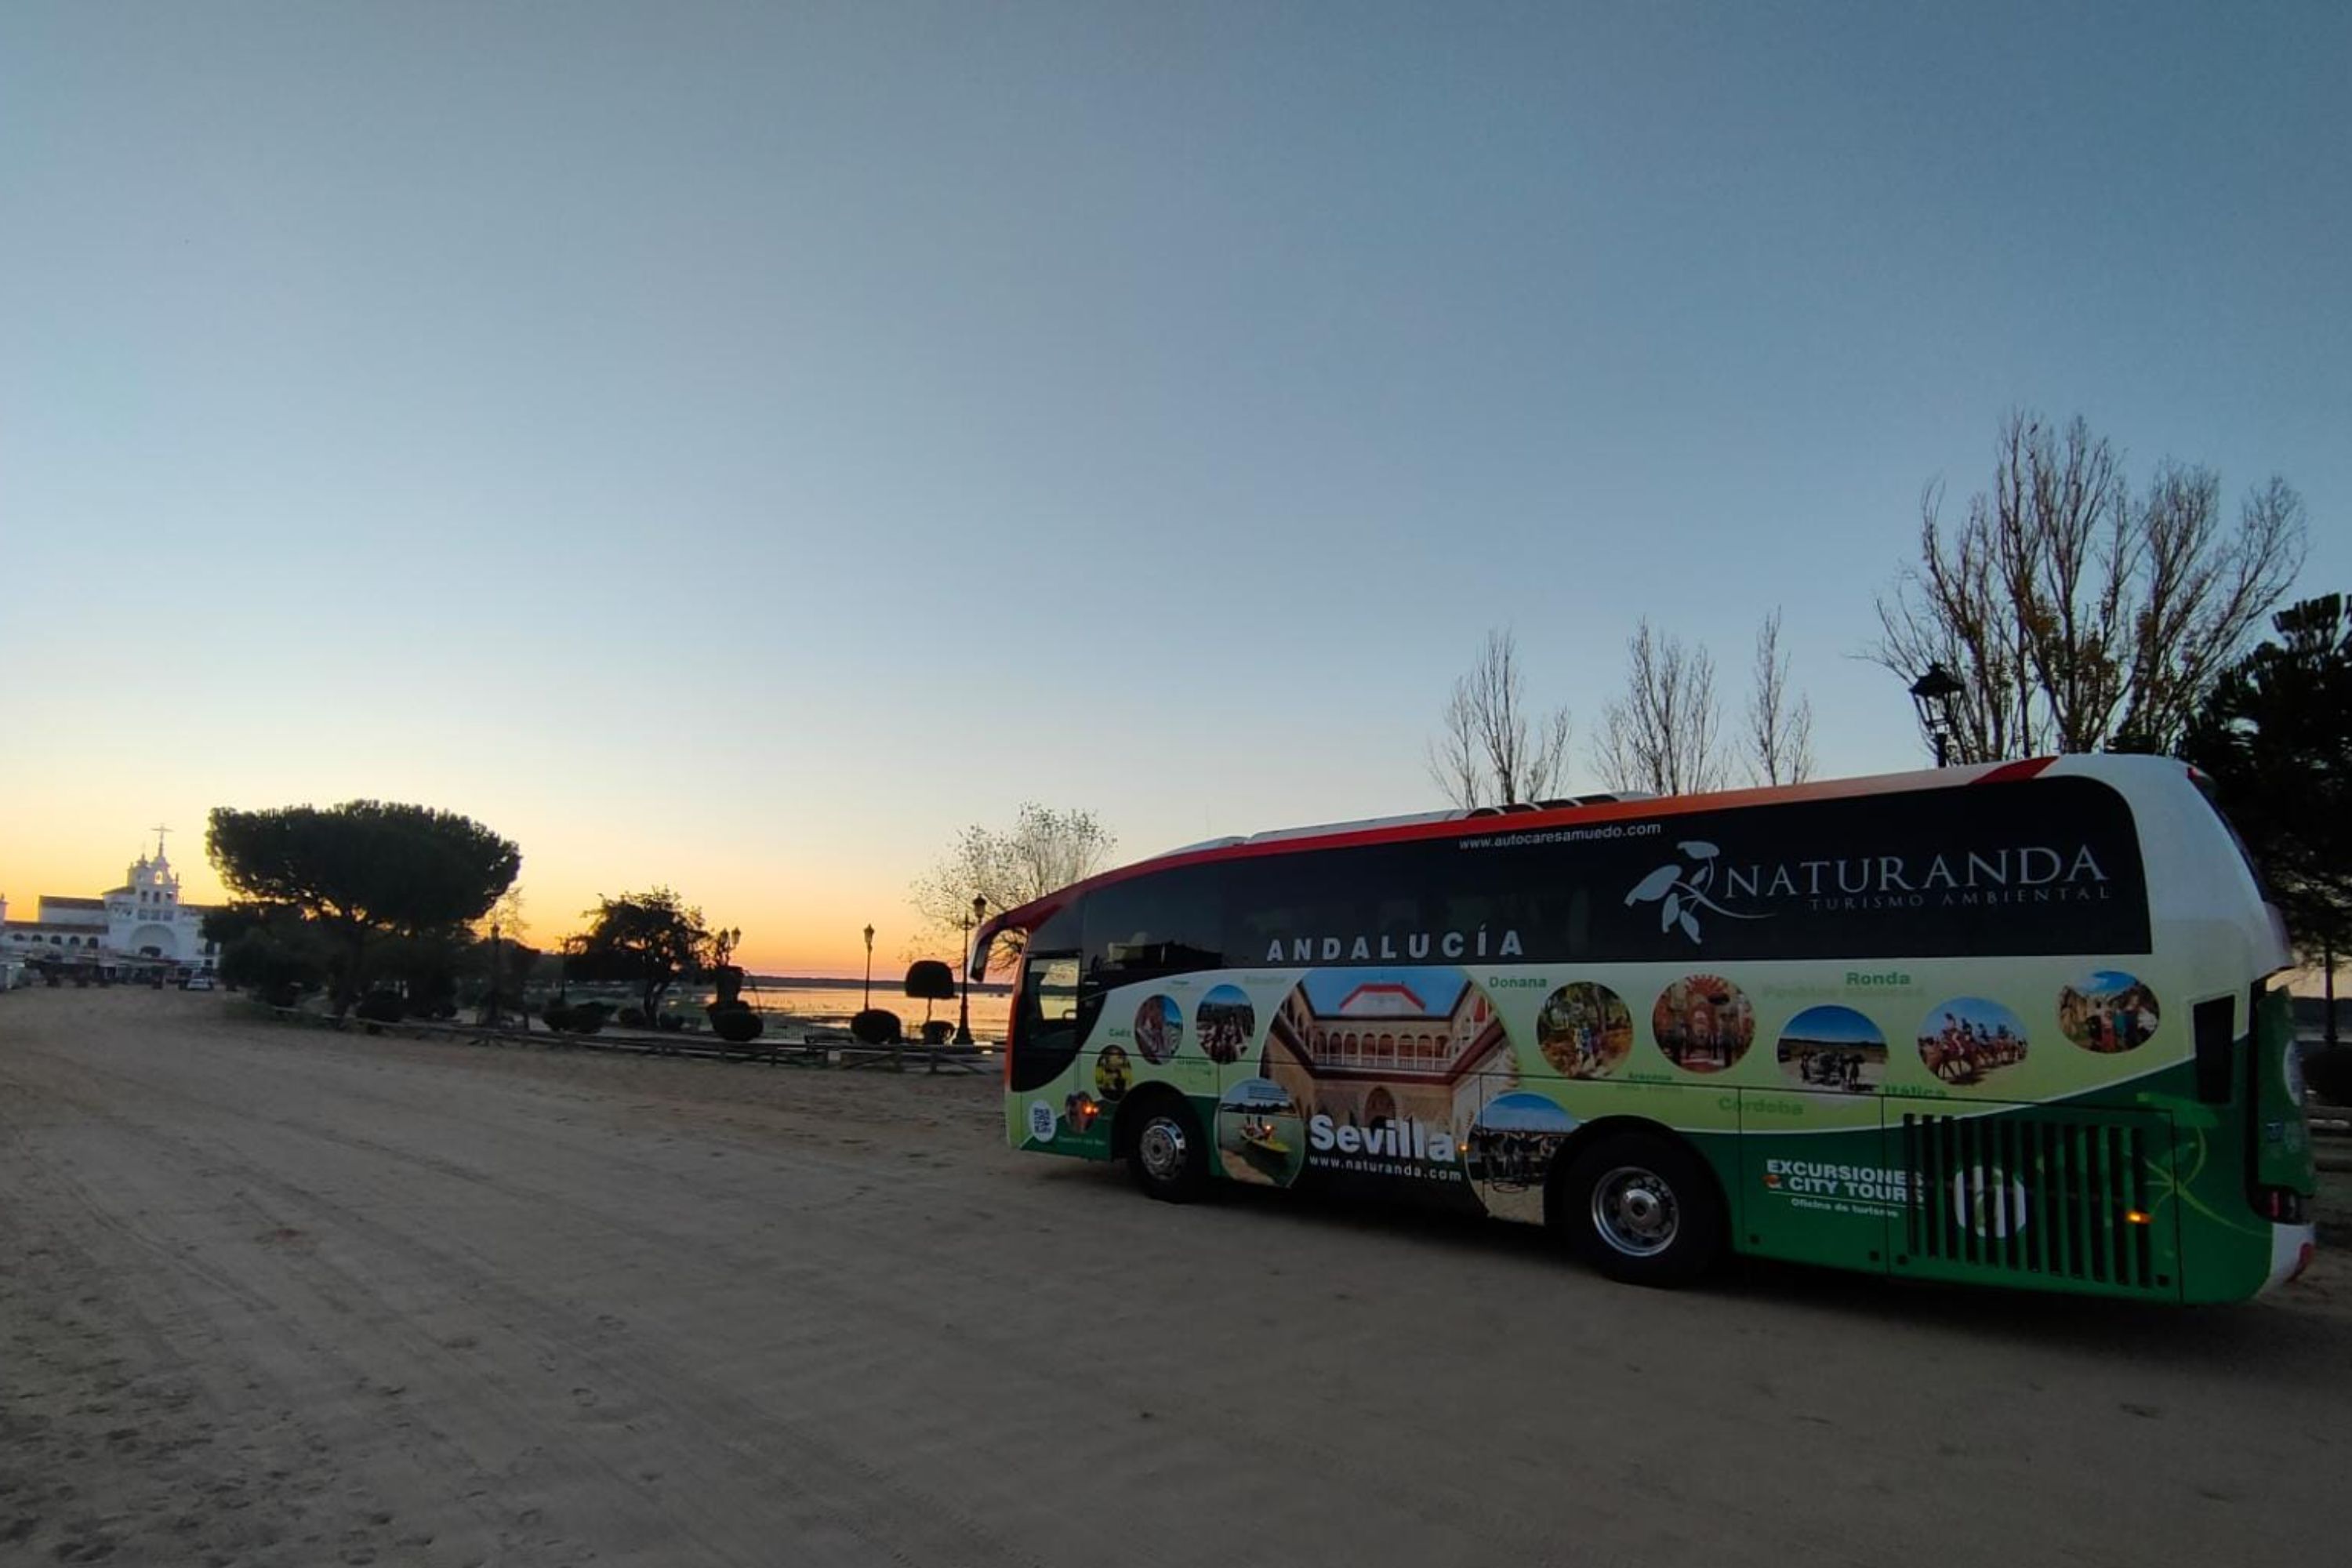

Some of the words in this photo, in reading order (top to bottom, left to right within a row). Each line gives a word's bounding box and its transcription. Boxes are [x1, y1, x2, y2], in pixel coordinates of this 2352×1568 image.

[1725, 844, 2110, 898] NATURANDA
[1808, 894, 1925, 910] TURISMO
[1942, 886, 2110, 906] AMBIENTAL
[1266, 923, 1523, 961] ANDALUCÍA
[1845, 971, 1911, 985] Ronda
[1309, 1115, 1454, 1162] Sevilla
[1309, 1154, 1461, 1181] www.naturanda.com
[1788, 1176, 1838, 1194] CITY
